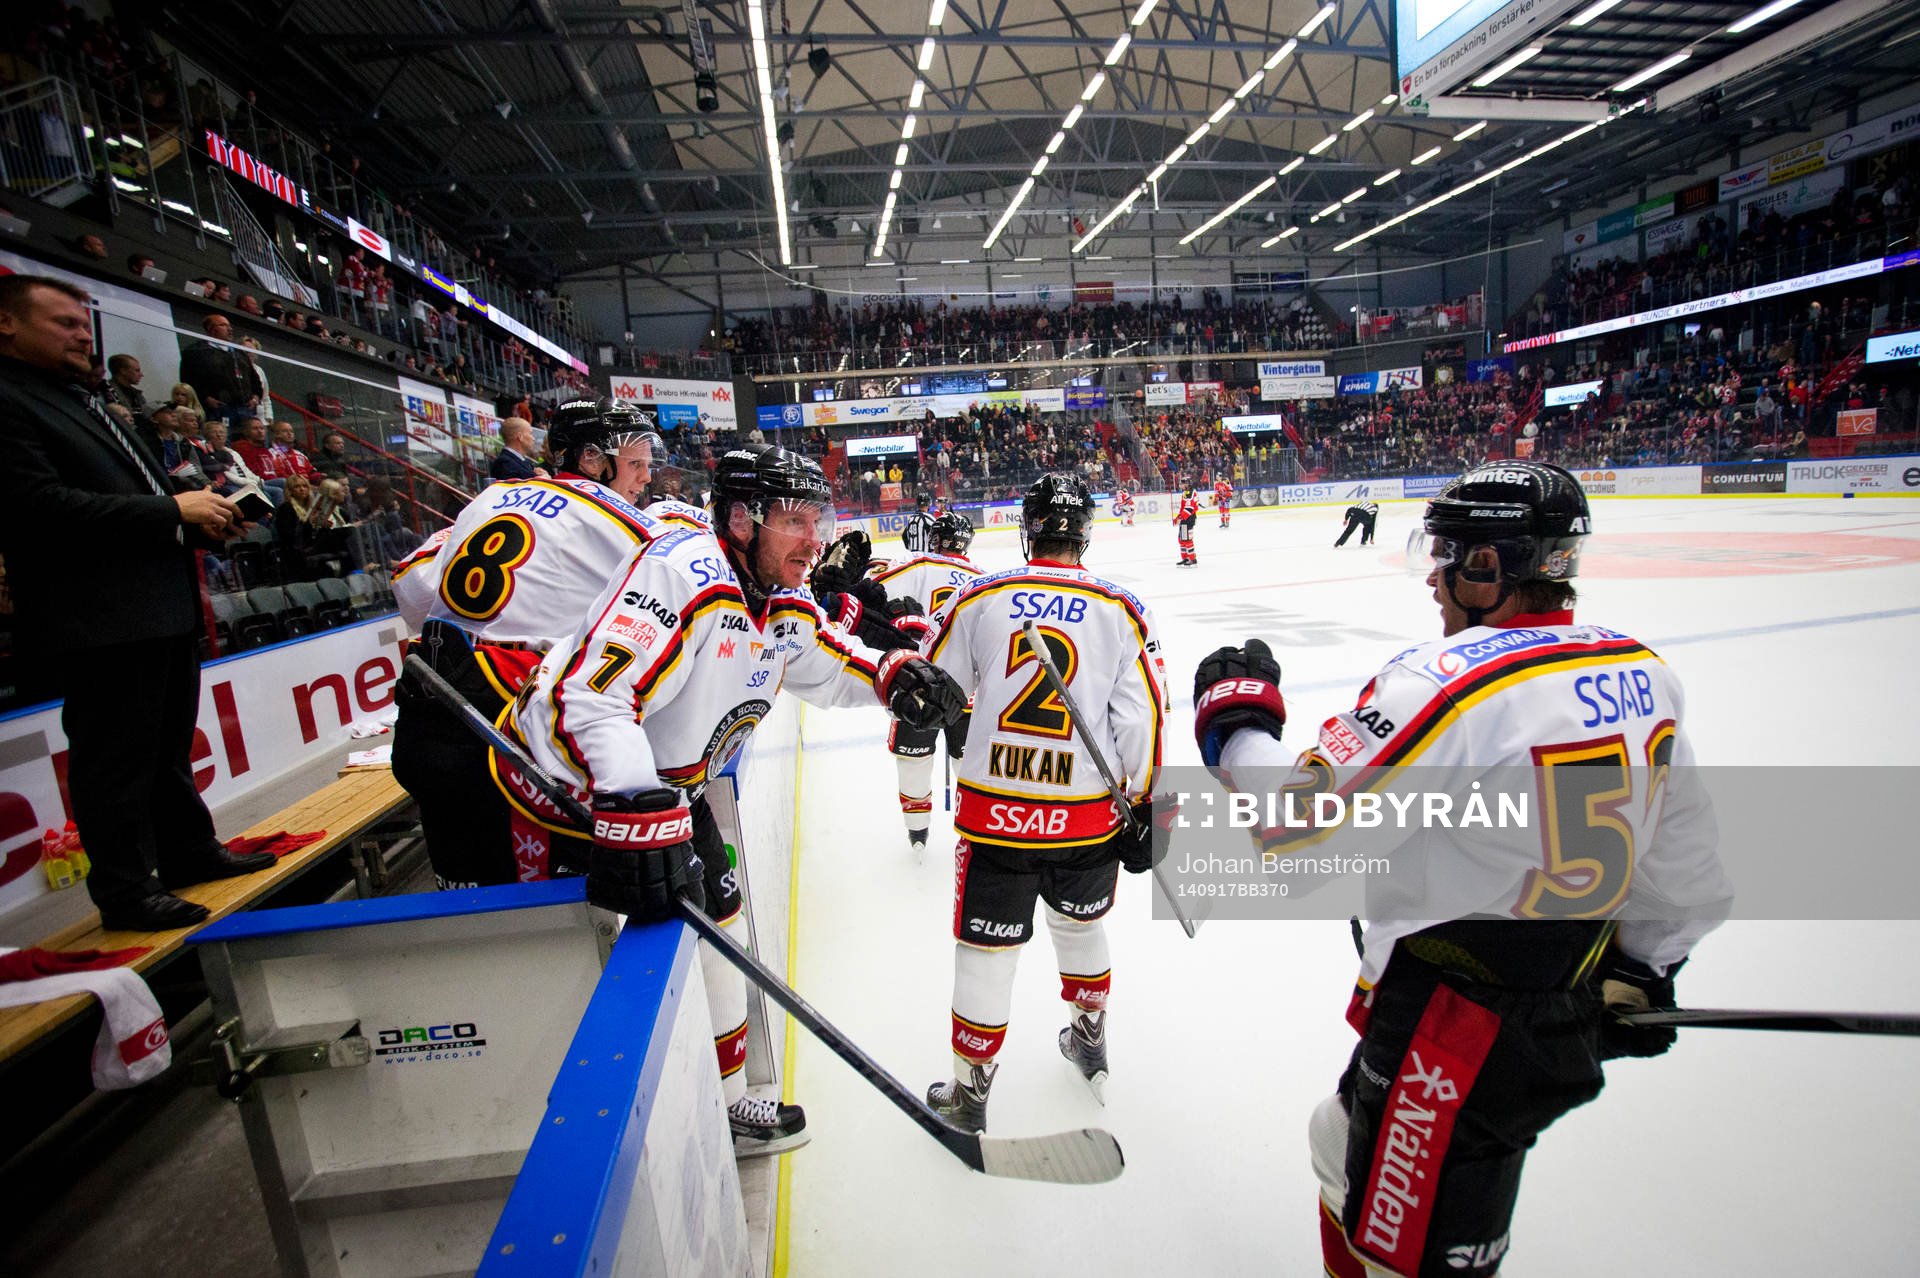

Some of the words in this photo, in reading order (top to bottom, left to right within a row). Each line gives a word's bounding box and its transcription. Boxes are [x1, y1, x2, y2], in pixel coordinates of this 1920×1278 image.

[1413, 76, 1424, 88] En
[1425, 66, 1438, 80] bra
[1440, 33, 1487, 70] förpackning
[1683, 296, 1728, 313] Partners
[1262, 364, 1321, 376] Vintergatan
[614, 382, 638, 399] MAX
[655, 388, 679, 397] Örebro
[680, 390, 708, 398] HK-målet
[712, 386, 731, 402] MAX
[1344, 381, 1371, 392] KPMG
[850, 405, 889, 416] Swegon
[1713, 473, 1785, 484] CONVENTUM
[1792, 466, 1846, 480] TRUCK
[1065, 494, 1083, 507] Tele
[1282, 486, 1335, 498] HOIST
[492, 487, 569, 519] SSAB
[1058, 517, 1069, 531] 2
[956, 541, 965, 549] 29
[439, 512, 536, 622] 8
[638, 594, 679, 630] LKAB
[1009, 591, 1087, 623] SSAB
[609, 622, 652, 650] SPORTIA
[630, 618, 657, 640] TEAM
[1463, 629, 1552, 660] CORVARA
[587, 641, 636, 694] 7
[998, 625, 1079, 740] 2
[1574, 669, 1655, 729] SSAB
[1329, 720, 1363, 757] TEAM
[907, 746, 931, 755] LKAB
[989, 741, 1075, 787] KUKAN
[595, 815, 693, 843] BAUER
[986, 804, 1069, 835] SSAB
[1075, 896, 1109, 915] LKAB
[984, 921, 1024, 938] LKAB
[378, 1022, 477, 1046] DACO
[956, 1030, 994, 1051] NEX
[1363, 1089, 1438, 1254] Näiden
